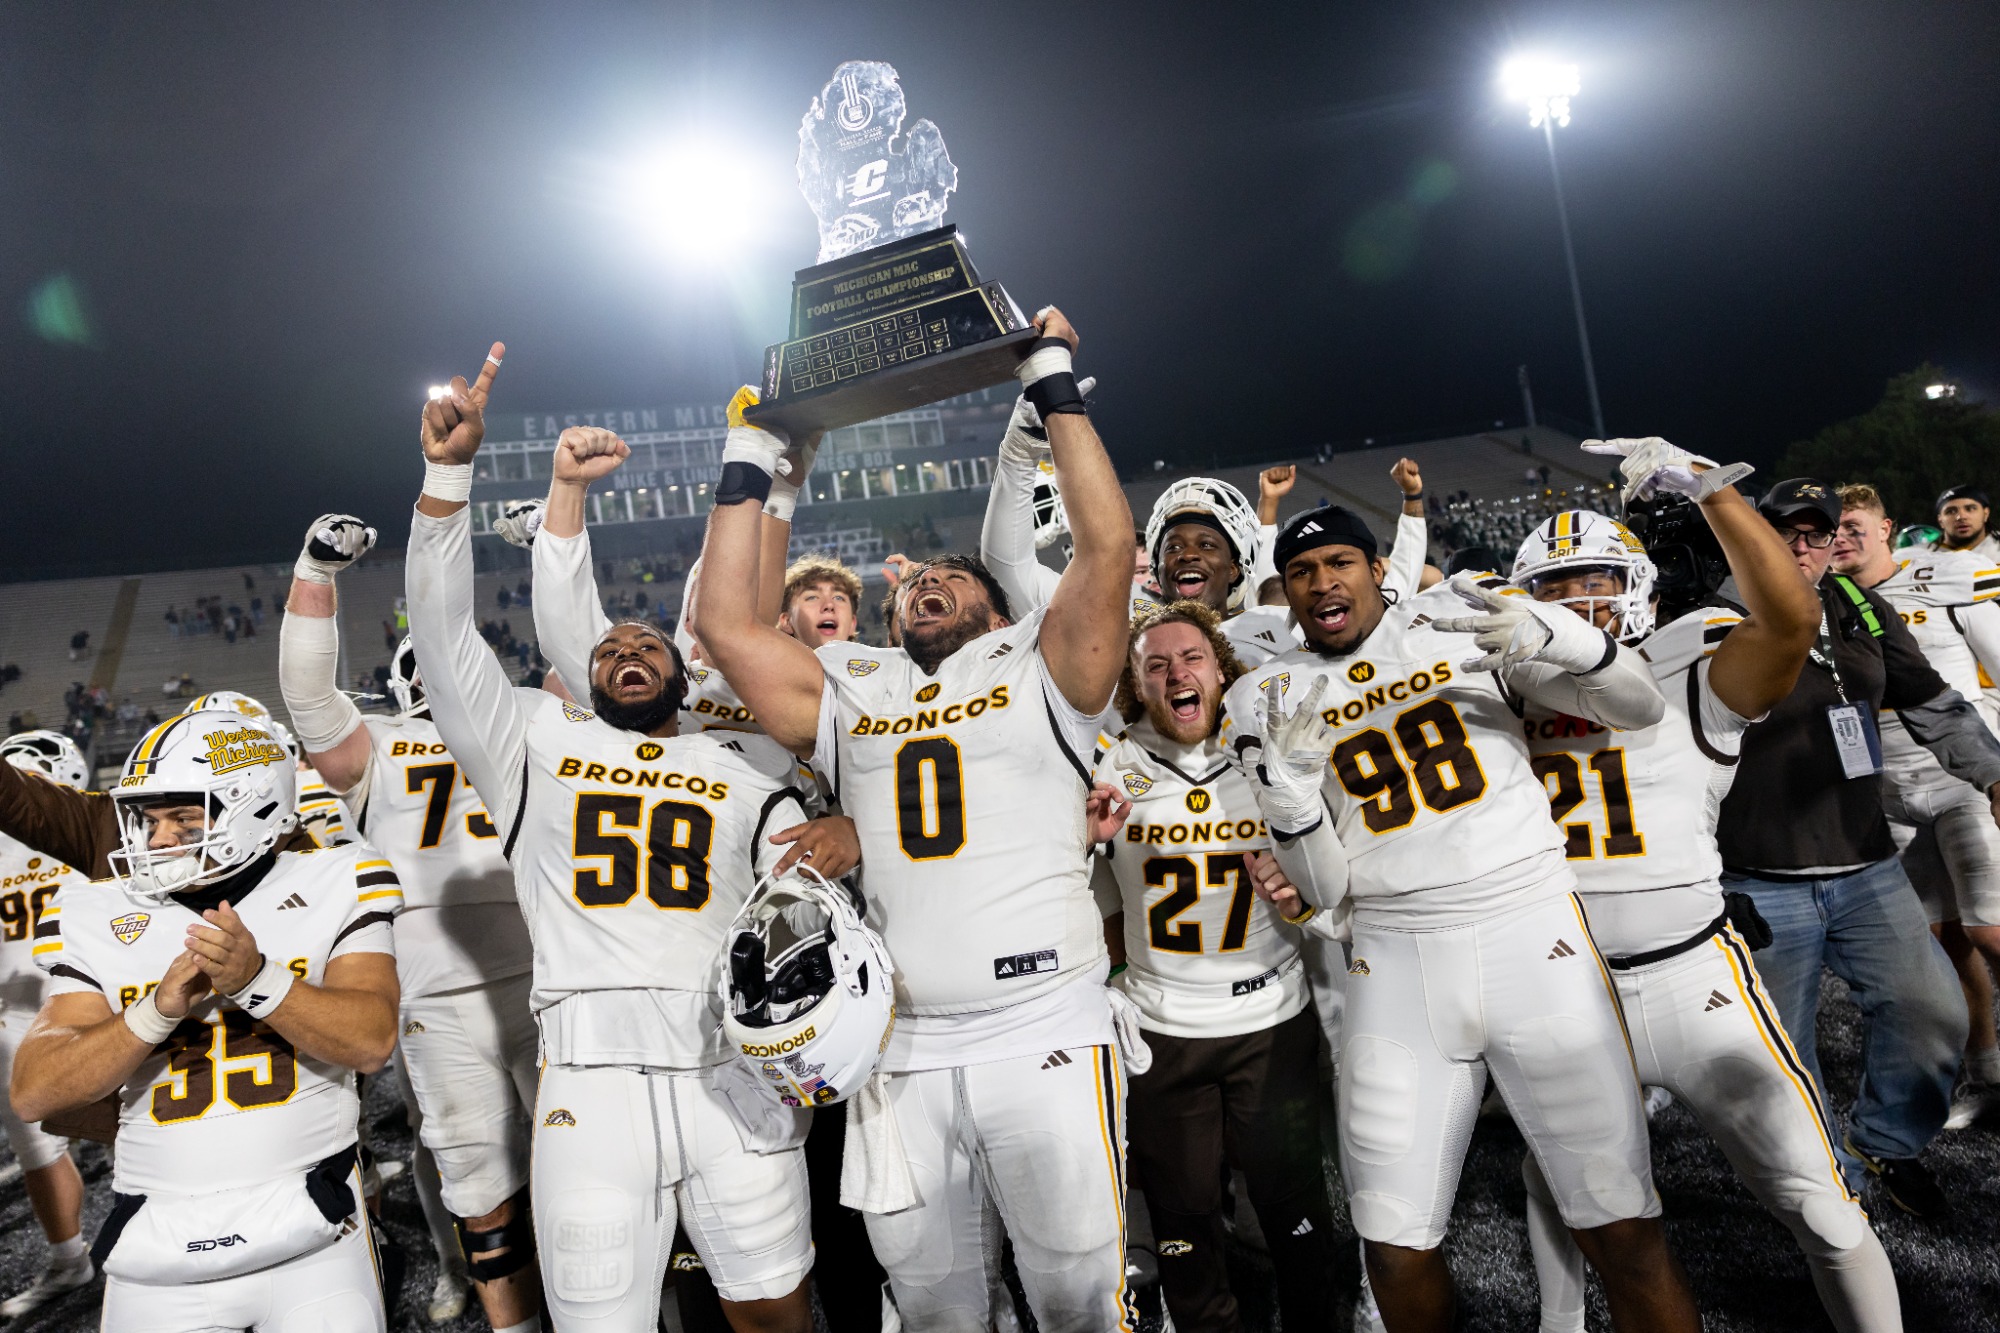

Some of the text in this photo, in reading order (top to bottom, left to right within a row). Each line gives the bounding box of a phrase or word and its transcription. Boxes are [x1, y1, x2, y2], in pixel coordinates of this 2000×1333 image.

[806, 266, 955, 319] FOOTBALL CHAMPIONSHIP
[832, 260, 919, 295] MICHIGAN MAC
[523, 409, 658, 438] EASTERN
[817, 451, 894, 472] RESS BOX
[613, 470, 657, 490] MIKE
[664, 470, 675, 485] &
[1548, 547, 1580, 560] GRIT
[1913, 566, 1934, 581] C
[693, 698, 755, 723] BRO
[849, 684, 1011, 737] BRONCOS
[1321, 661, 1453, 729] RONCOS
[203, 726, 271, 750] Western
[205, 740, 287, 771] Michigan
[1331, 696, 1488, 836] 98
[121, 775, 150, 788] GRIT
[556, 756, 730, 802] BRONCOS
[893, 733, 968, 863] 0
[1530, 746, 1647, 861] 21
[571, 791, 716, 912] 58
[1142, 850, 1262, 956] 27
[741, 1025, 817, 1058] BRONCOS
[150, 1007, 299, 1126] 35
[557, 1220, 629, 1252] JESUS
[563, 1261, 620, 1291] KING
